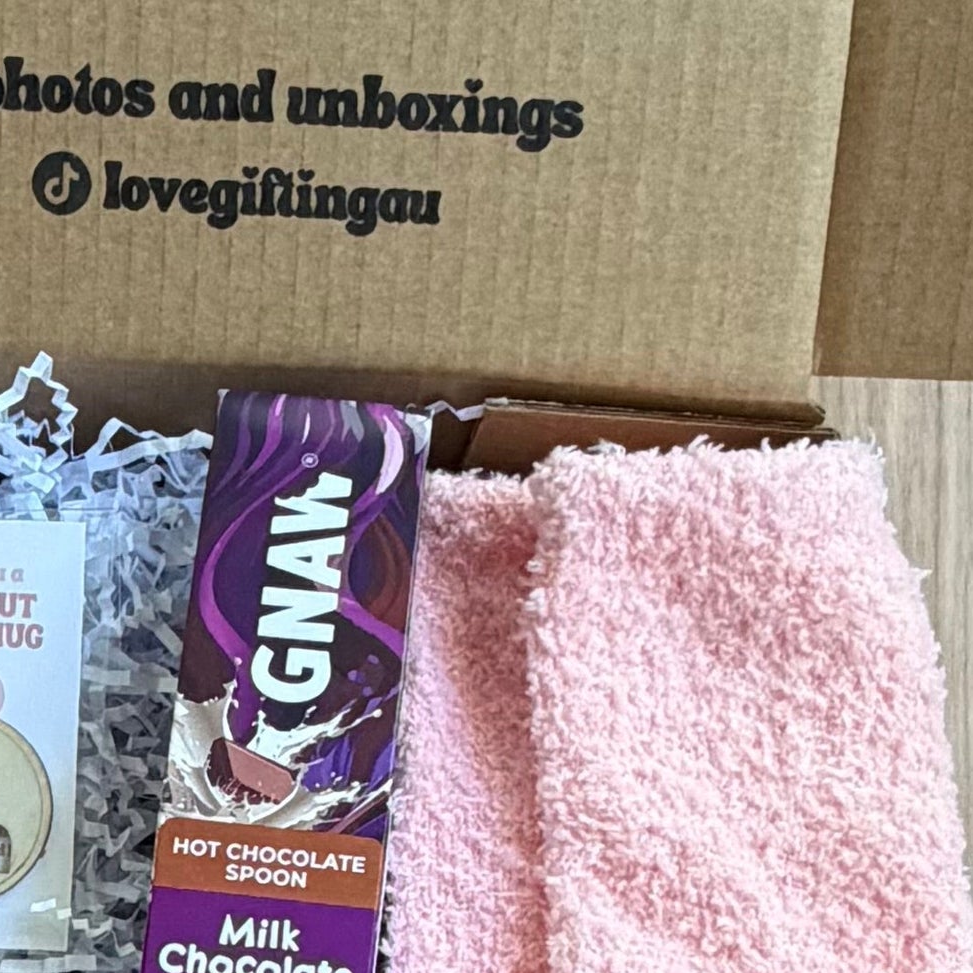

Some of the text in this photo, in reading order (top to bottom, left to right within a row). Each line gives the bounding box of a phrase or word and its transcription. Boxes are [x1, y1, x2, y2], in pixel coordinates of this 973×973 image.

[168, 68, 277, 123] and
[287, 74, 584, 152] unboxings
[103, 160, 441, 236] lovegiftingau
[10, 568, 24, 583] a
[250, 471, 353, 703] GNAW
[173, 837, 366, 873] HOT CHOCOLATE
[225, 864, 308, 888] SPOON
[219, 914, 301, 952] Milk
